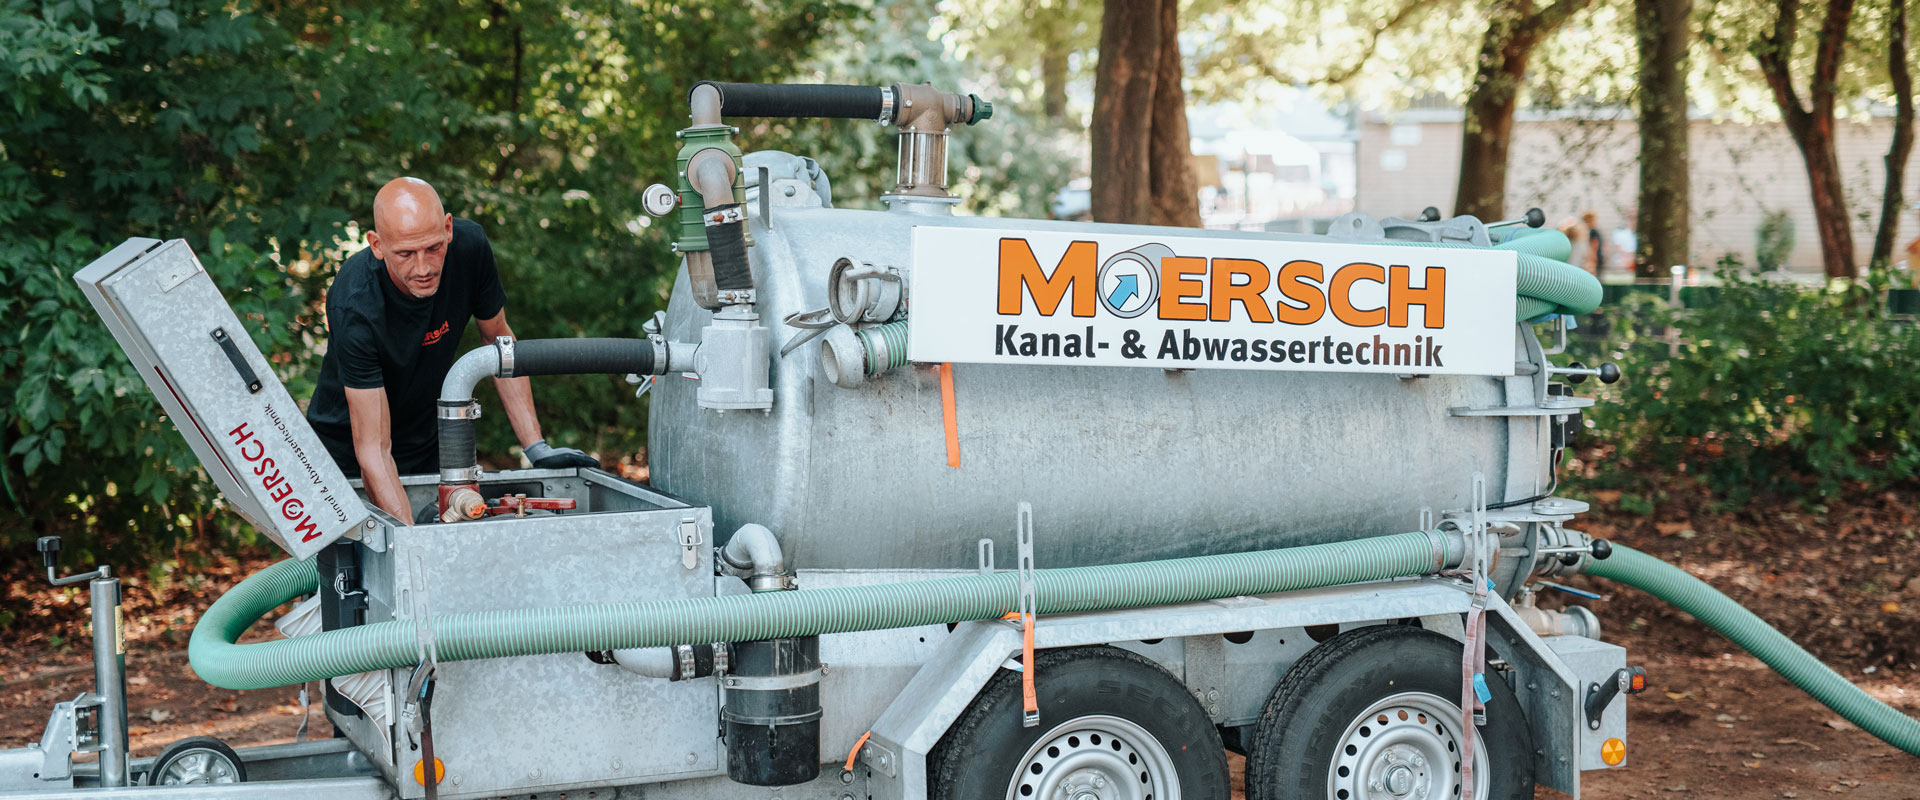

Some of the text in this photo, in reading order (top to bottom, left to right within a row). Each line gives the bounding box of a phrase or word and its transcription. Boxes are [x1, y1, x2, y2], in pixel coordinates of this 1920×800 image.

[997, 237, 1446, 329] MOERSCH
[995, 324, 1444, 367] Kanal- & Abwassertechnik
[229, 422, 322, 543] MOERSCH
[264, 403, 322, 485] Abwassertechnik
[324, 494, 348, 524] Kanal
